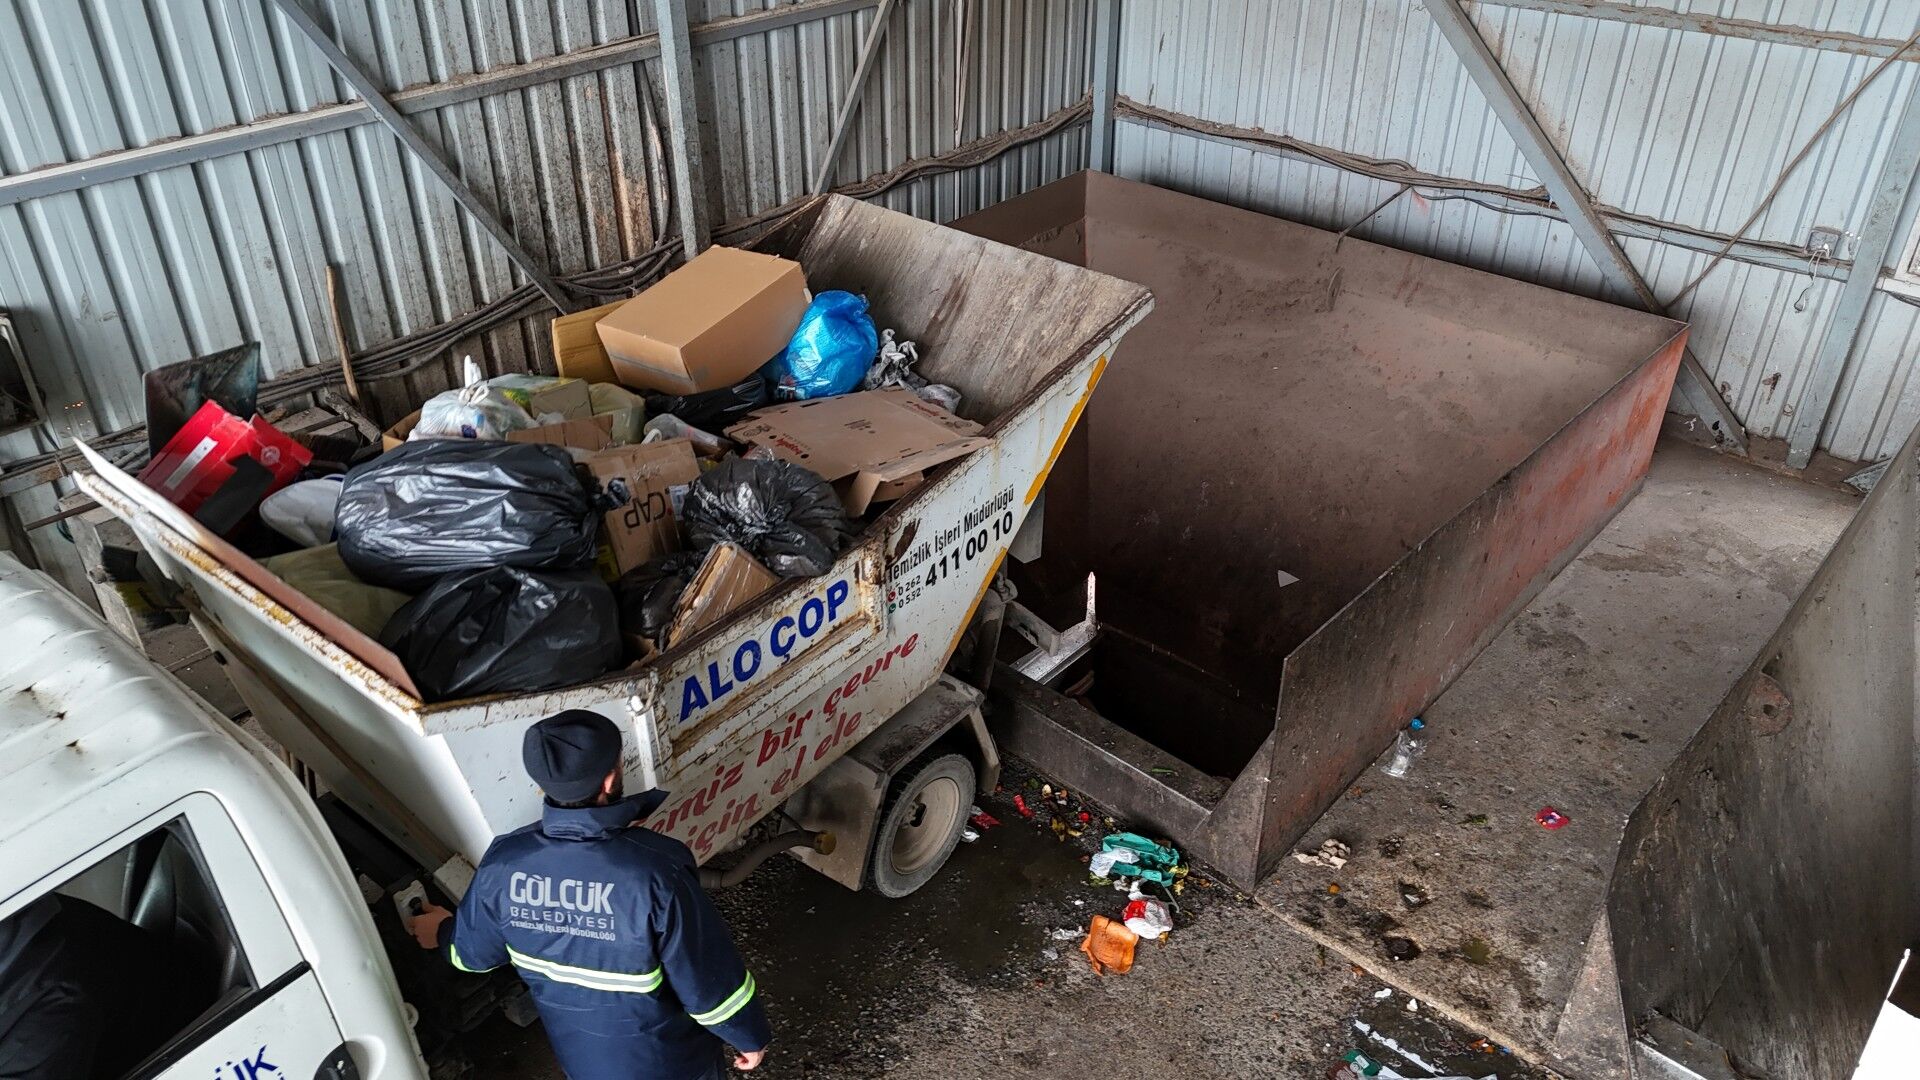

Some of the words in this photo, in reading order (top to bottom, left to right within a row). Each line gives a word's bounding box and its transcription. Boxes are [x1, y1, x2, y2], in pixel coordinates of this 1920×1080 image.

[888, 541, 932, 583] Temizlik
[934, 519, 961, 556] İşleri
[963, 483, 1014, 534] Müdürlüğü
[897, 586, 904, 596] 0
[905, 575, 921, 592] 262
[925, 546, 960, 587] 411
[965, 528, 988, 561] 00
[992, 510, 1013, 542] 10
[898, 599, 904, 609] 0
[678, 639, 762, 724] ALO
[770, 579, 849, 666] ÇOP
[630, 761, 744, 833] emiz
[757, 709, 813, 767] bir
[823, 633, 919, 723] çevre
[770, 745, 806, 795] el
[814, 711, 862, 761] ele
[509, 871, 615, 915] GÖLCÜK
[510, 906, 615, 930] BELEDİYESİ
[510, 920, 545, 932] TEMİZLİK
